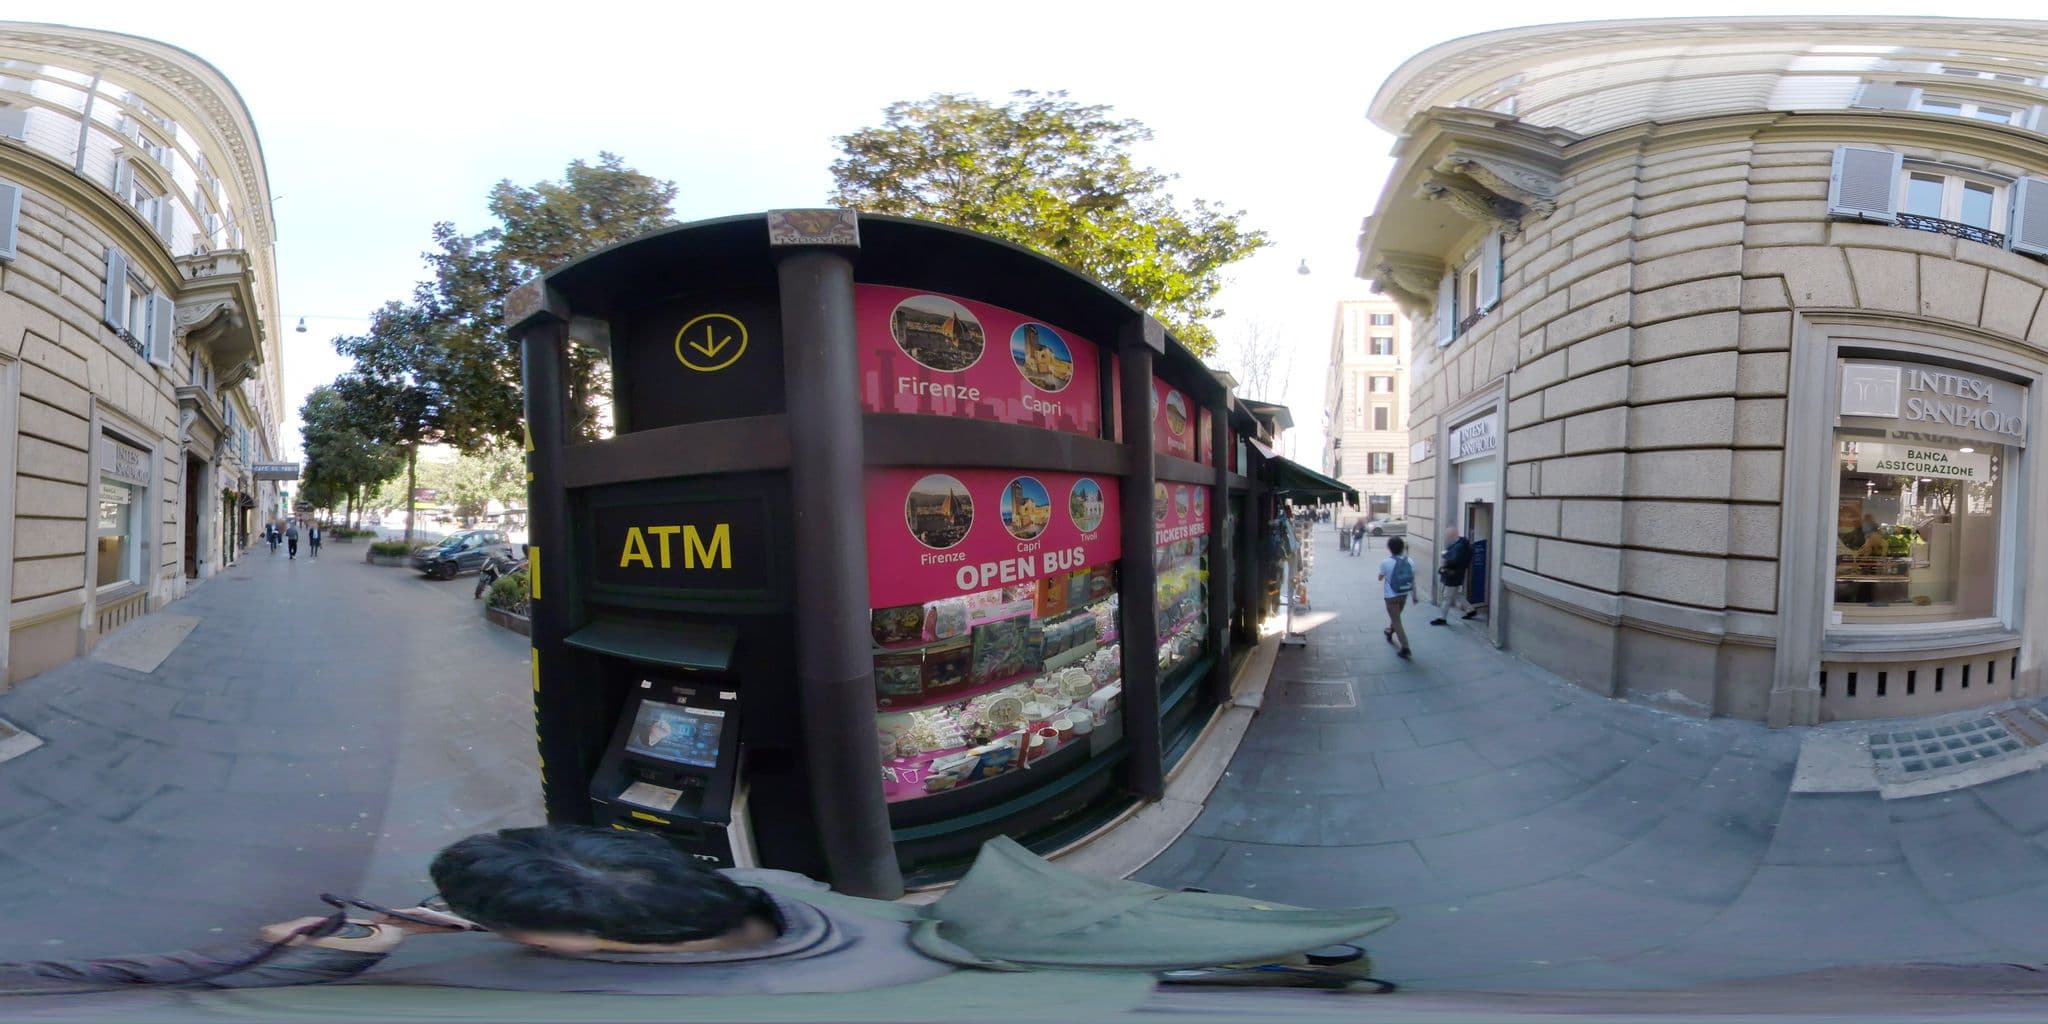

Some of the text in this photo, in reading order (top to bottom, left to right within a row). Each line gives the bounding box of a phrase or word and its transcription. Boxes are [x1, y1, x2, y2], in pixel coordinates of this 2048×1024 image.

[898, 376, 1062, 417] Firenze Capri
[1907, 368, 1993, 404] INTESA
[1906, 397, 2025, 436] SANPAOLO
[1876, 460, 1973, 477] ASSICURAZIONE
[1907, 449, 1948, 462] BANCA
[620, 523, 732, 569] ATM
[921, 533, 1097, 566] Firenze Capri Tivoli
[1155, 522, 1205, 545] TICKETS HERE
[956, 546, 1085, 590] OPEN BUS
